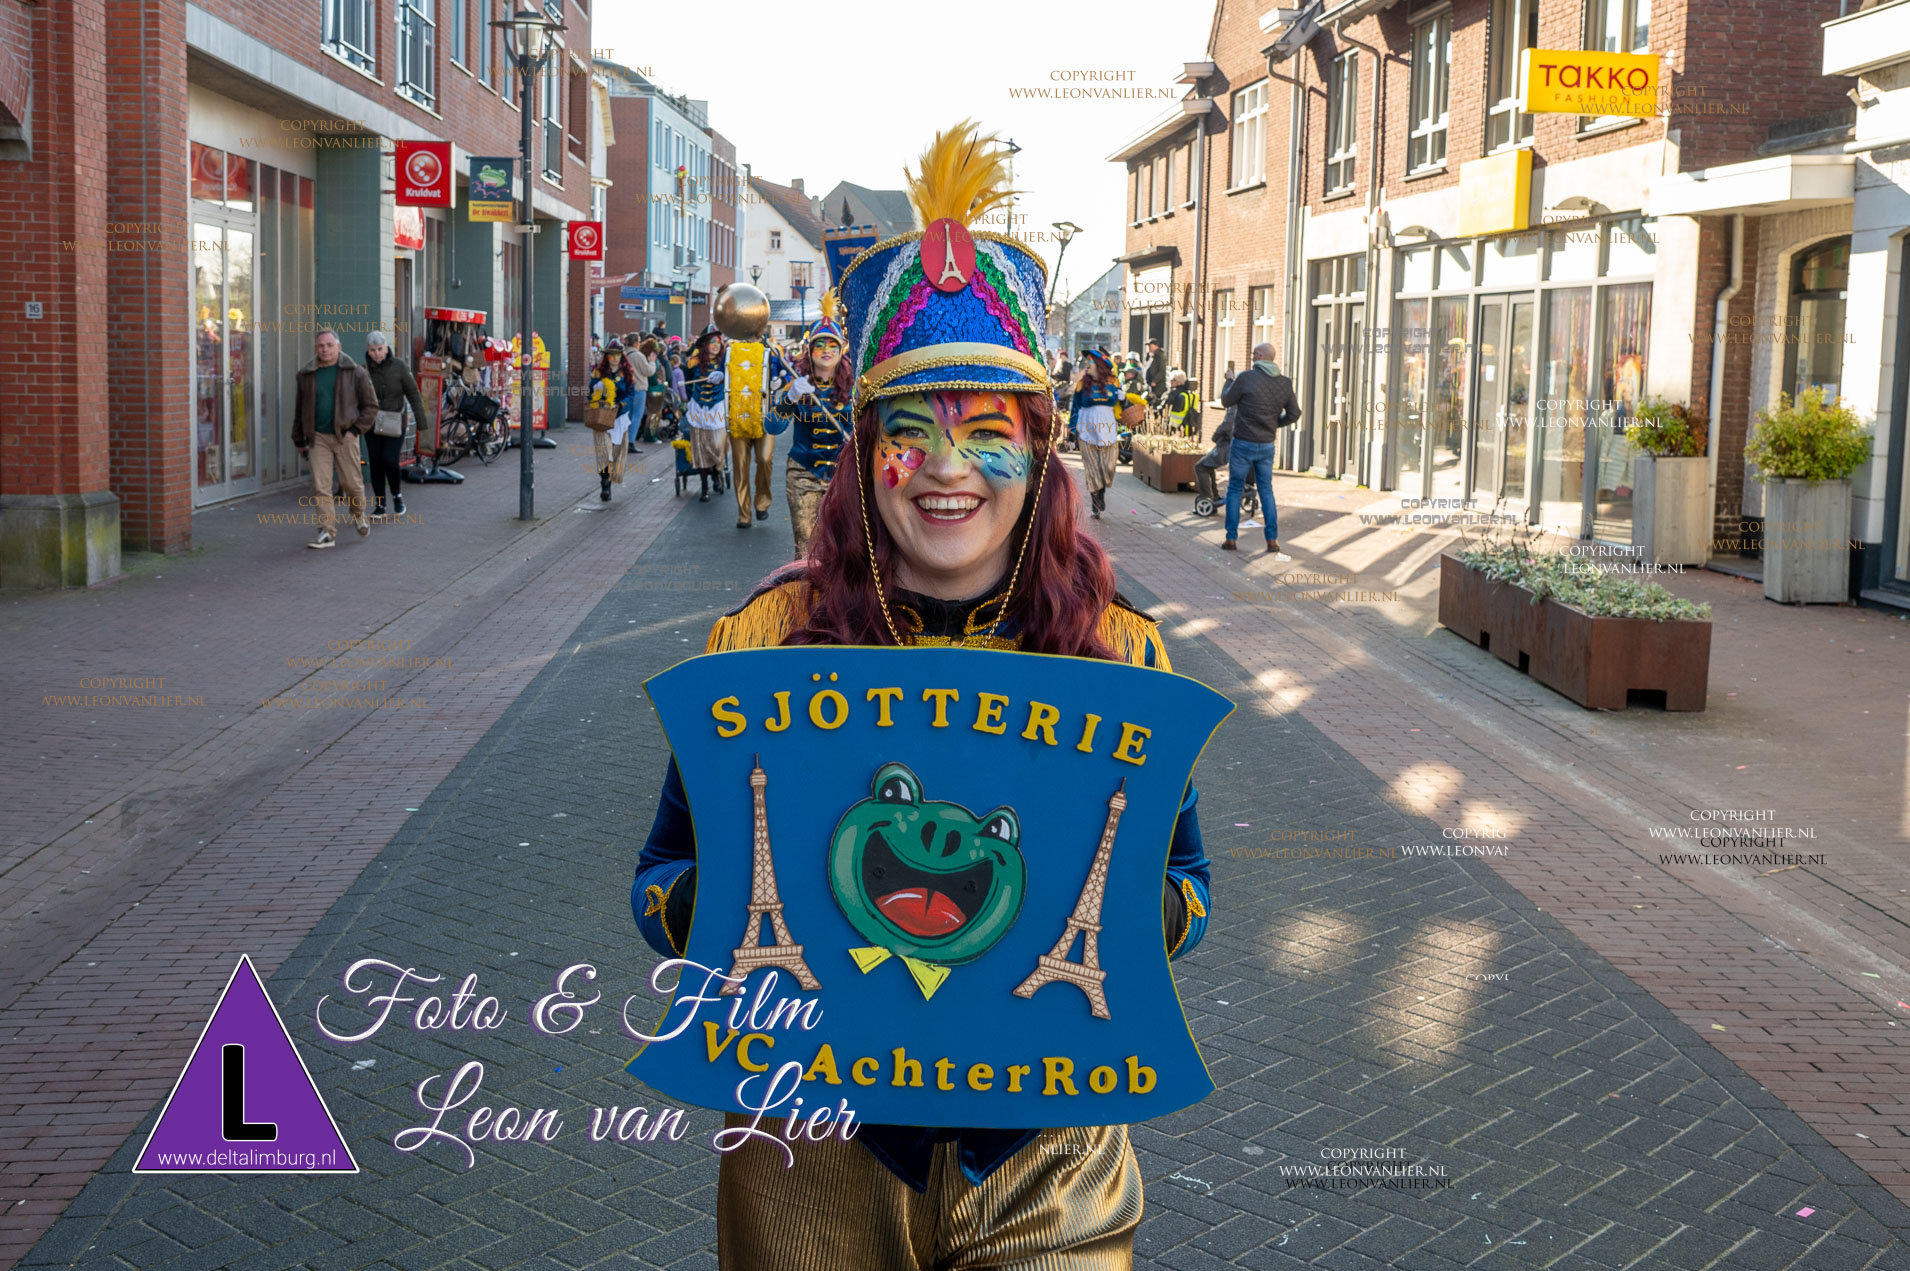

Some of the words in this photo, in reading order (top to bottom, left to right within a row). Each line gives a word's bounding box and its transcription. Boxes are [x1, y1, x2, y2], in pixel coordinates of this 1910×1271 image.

[1554, 93, 1631, 105] FASHION
[405, 188, 441, 198] Kruidvat
[28, 303, 41, 314] 16
[711, 672, 1152, 766] SJÖTTERIE
[703, 1021, 774, 1073] VC
[802, 1043, 1158, 1096] AchterRob
